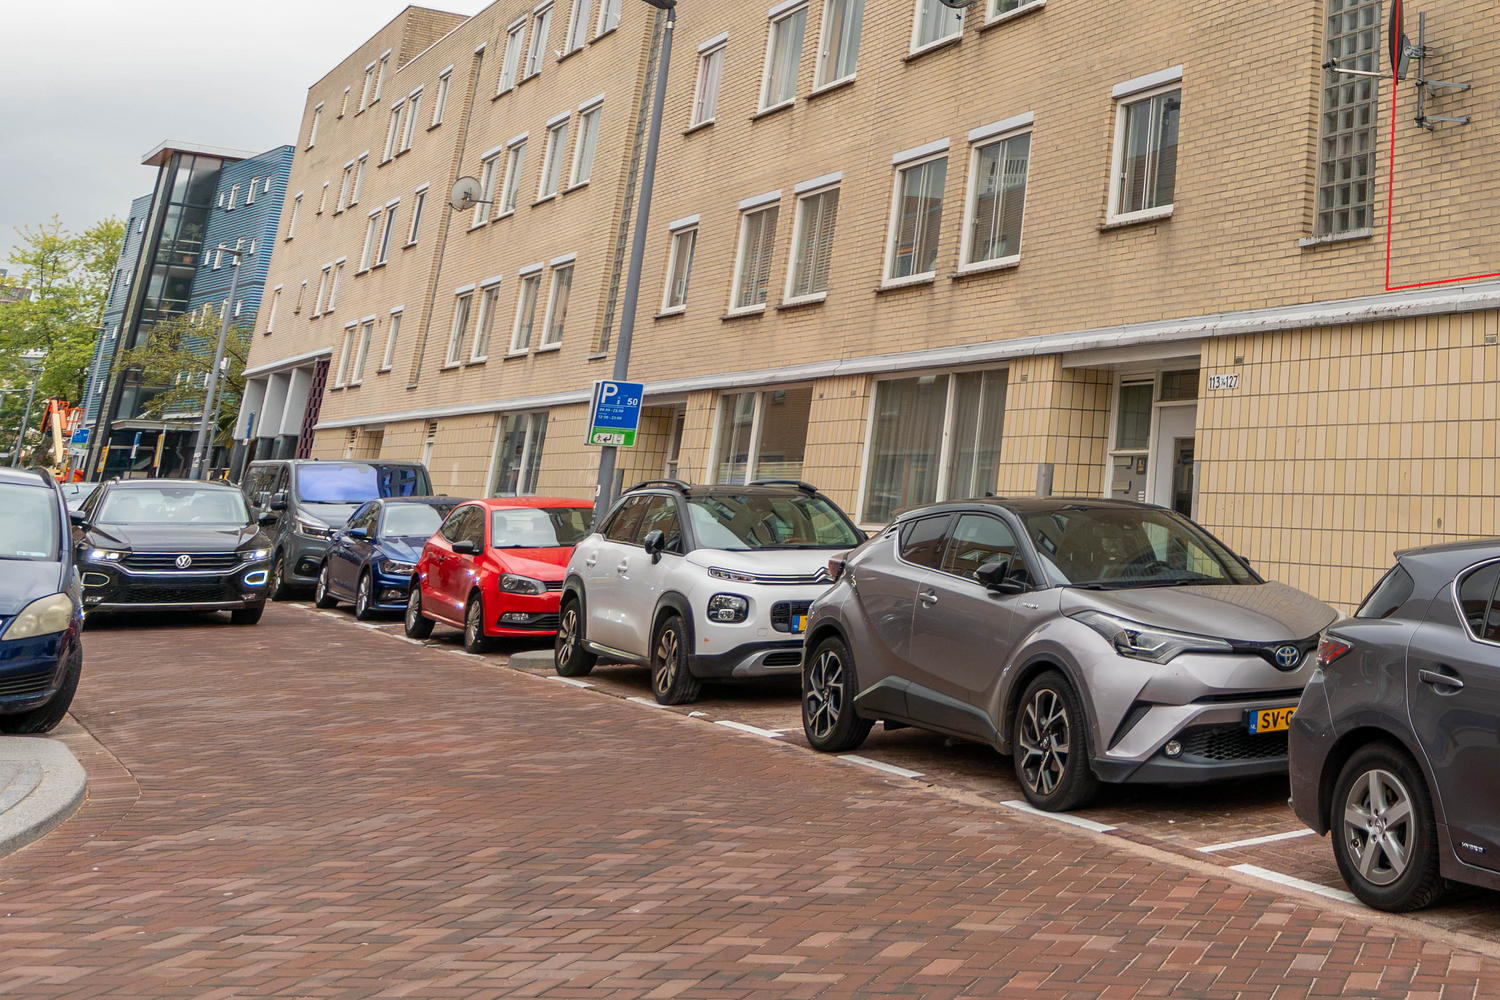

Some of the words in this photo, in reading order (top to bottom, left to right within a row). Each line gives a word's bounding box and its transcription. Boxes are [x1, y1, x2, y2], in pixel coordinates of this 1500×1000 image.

[1209, 376, 1221, 388] 113
[1226, 375, 1239, 388] 127
[601, 383, 619, 404] P
[627, 397, 638, 406] 50
